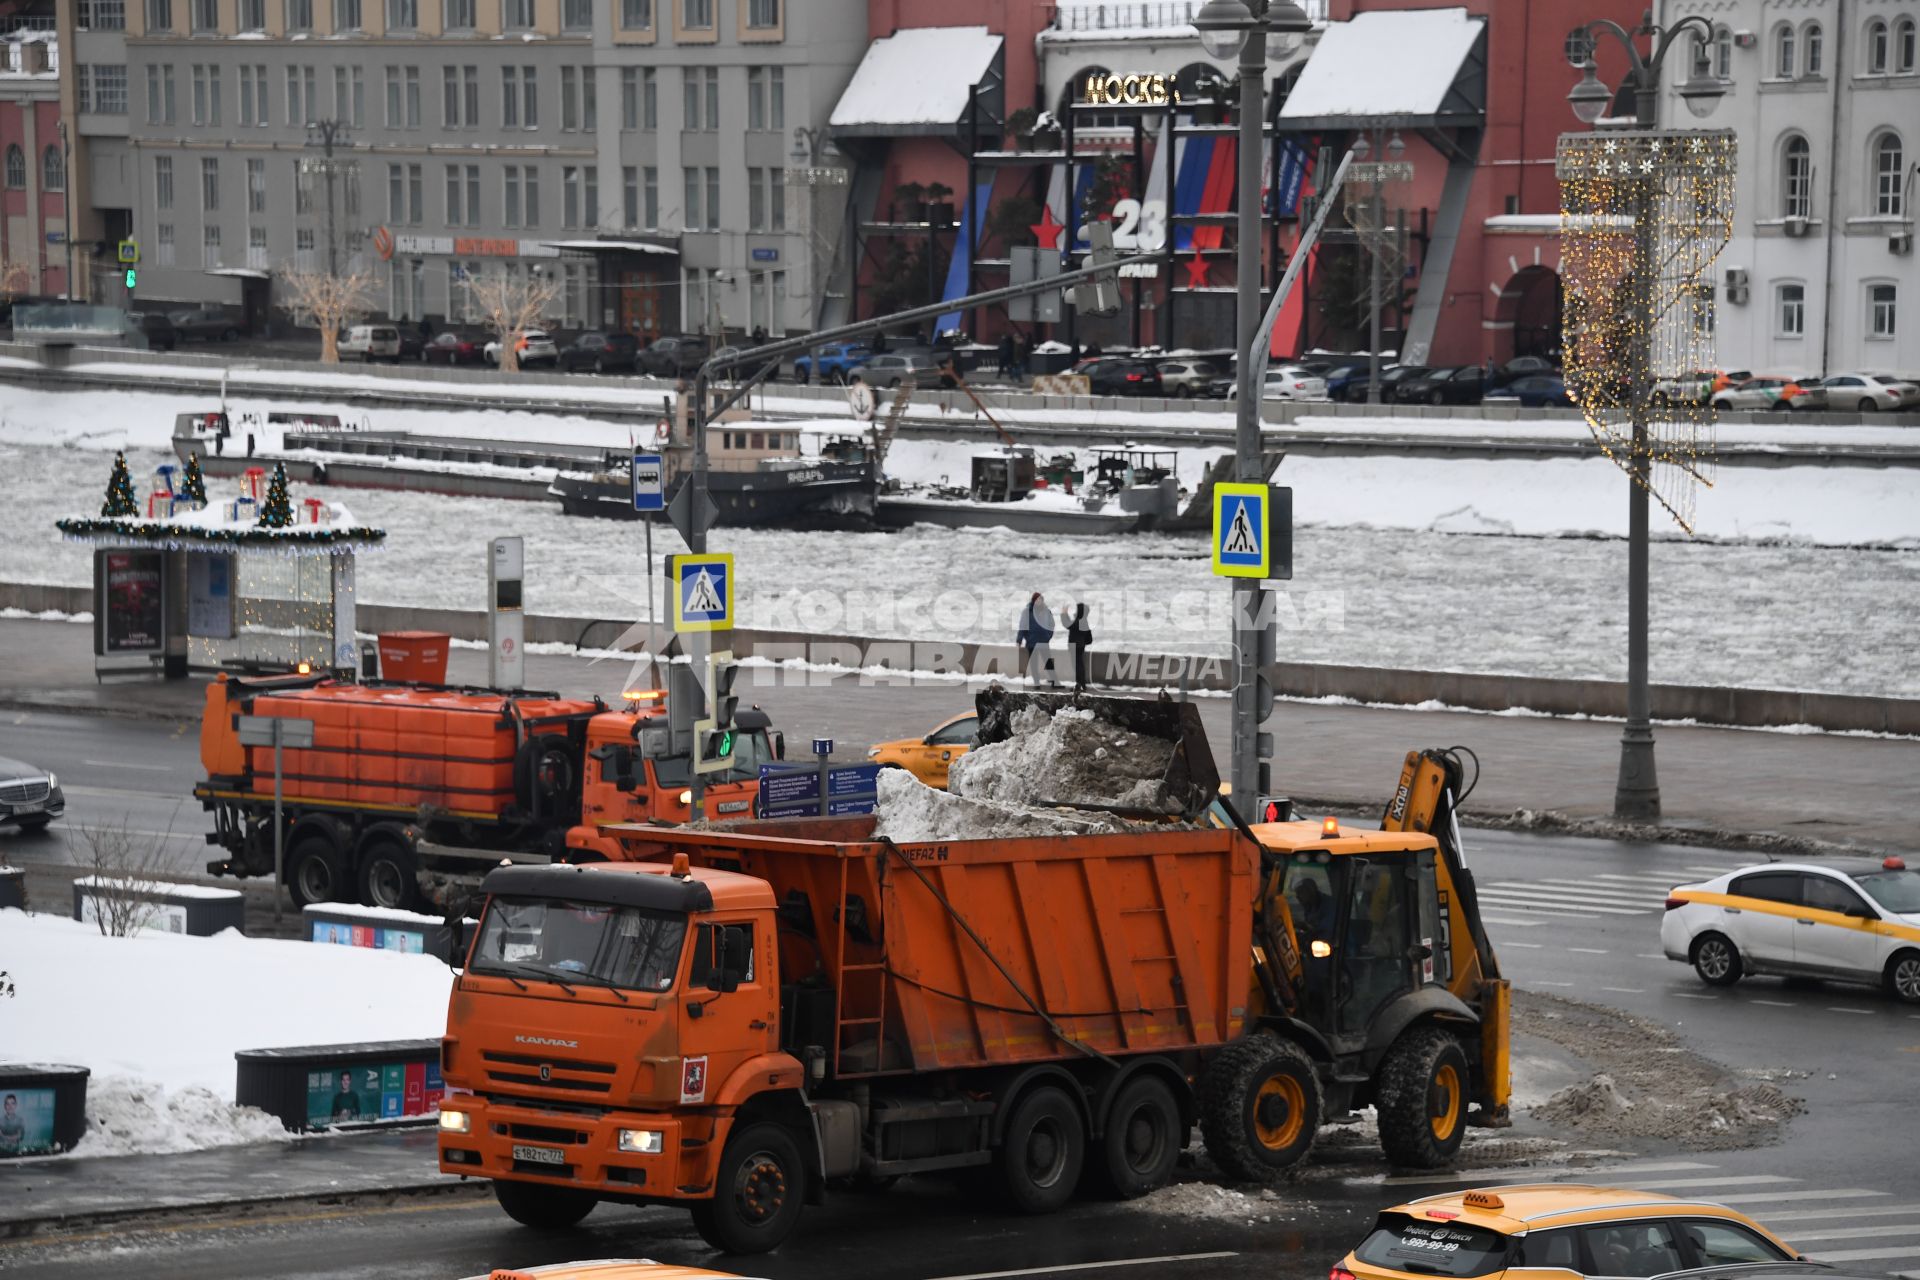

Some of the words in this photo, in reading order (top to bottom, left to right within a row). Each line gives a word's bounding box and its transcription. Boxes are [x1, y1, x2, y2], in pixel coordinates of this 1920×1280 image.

[1111, 199, 1167, 251] 23
[515, 1035, 578, 1048] KAMAZ
[1403, 1224, 1431, 1236] Яндекс
[1447, 1232, 1473, 1242] Такси
[1408, 1237, 1460, 1251] 999-99-99
